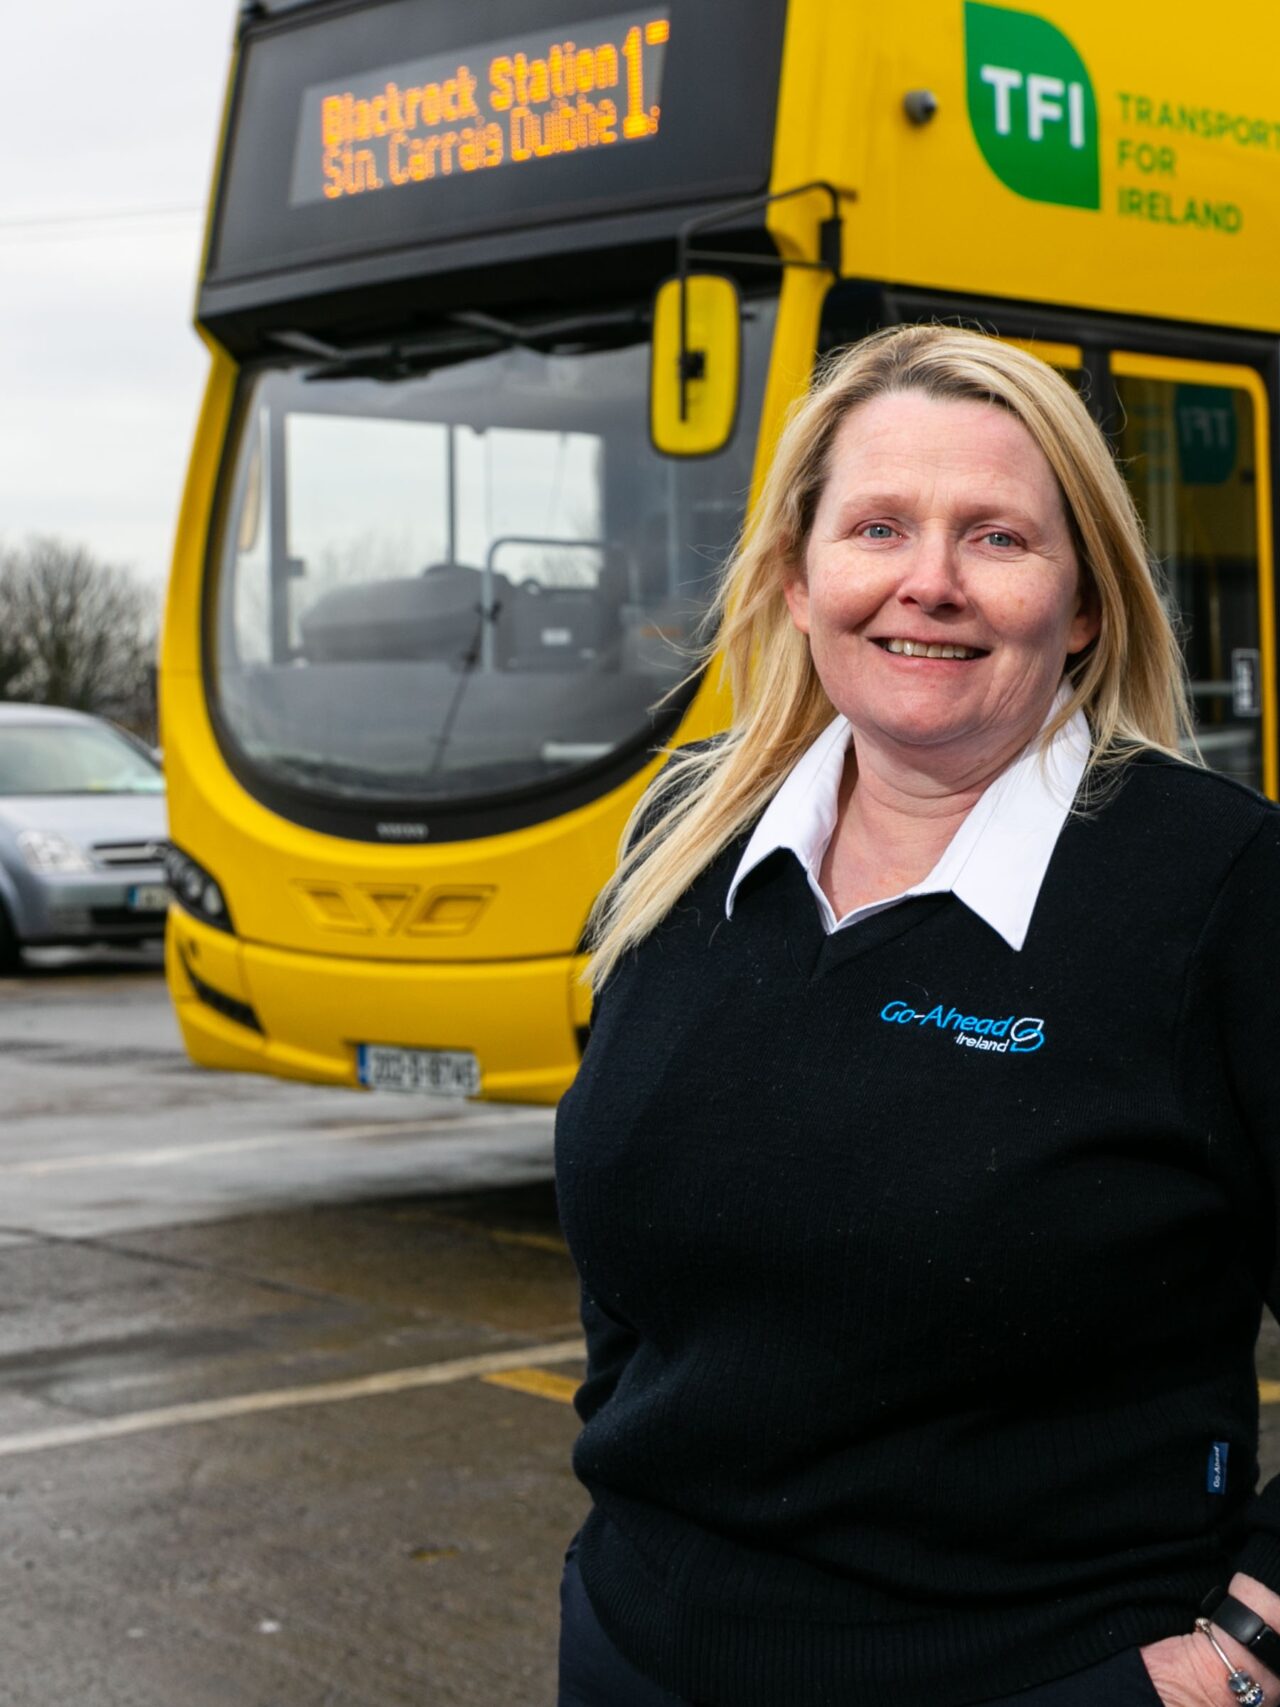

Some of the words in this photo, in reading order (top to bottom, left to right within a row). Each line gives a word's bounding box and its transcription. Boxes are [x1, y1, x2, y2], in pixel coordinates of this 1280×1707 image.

[322, 66, 478, 147] Blackrock
[489, 41, 618, 111] Station
[981, 65, 1084, 148] TFI
[1117, 140, 1177, 176] FOR
[1117, 187, 1242, 234] IRELAND
[880, 1000, 1015, 1037] Go-Ahead
[955, 1032, 1010, 1053] Ireland
